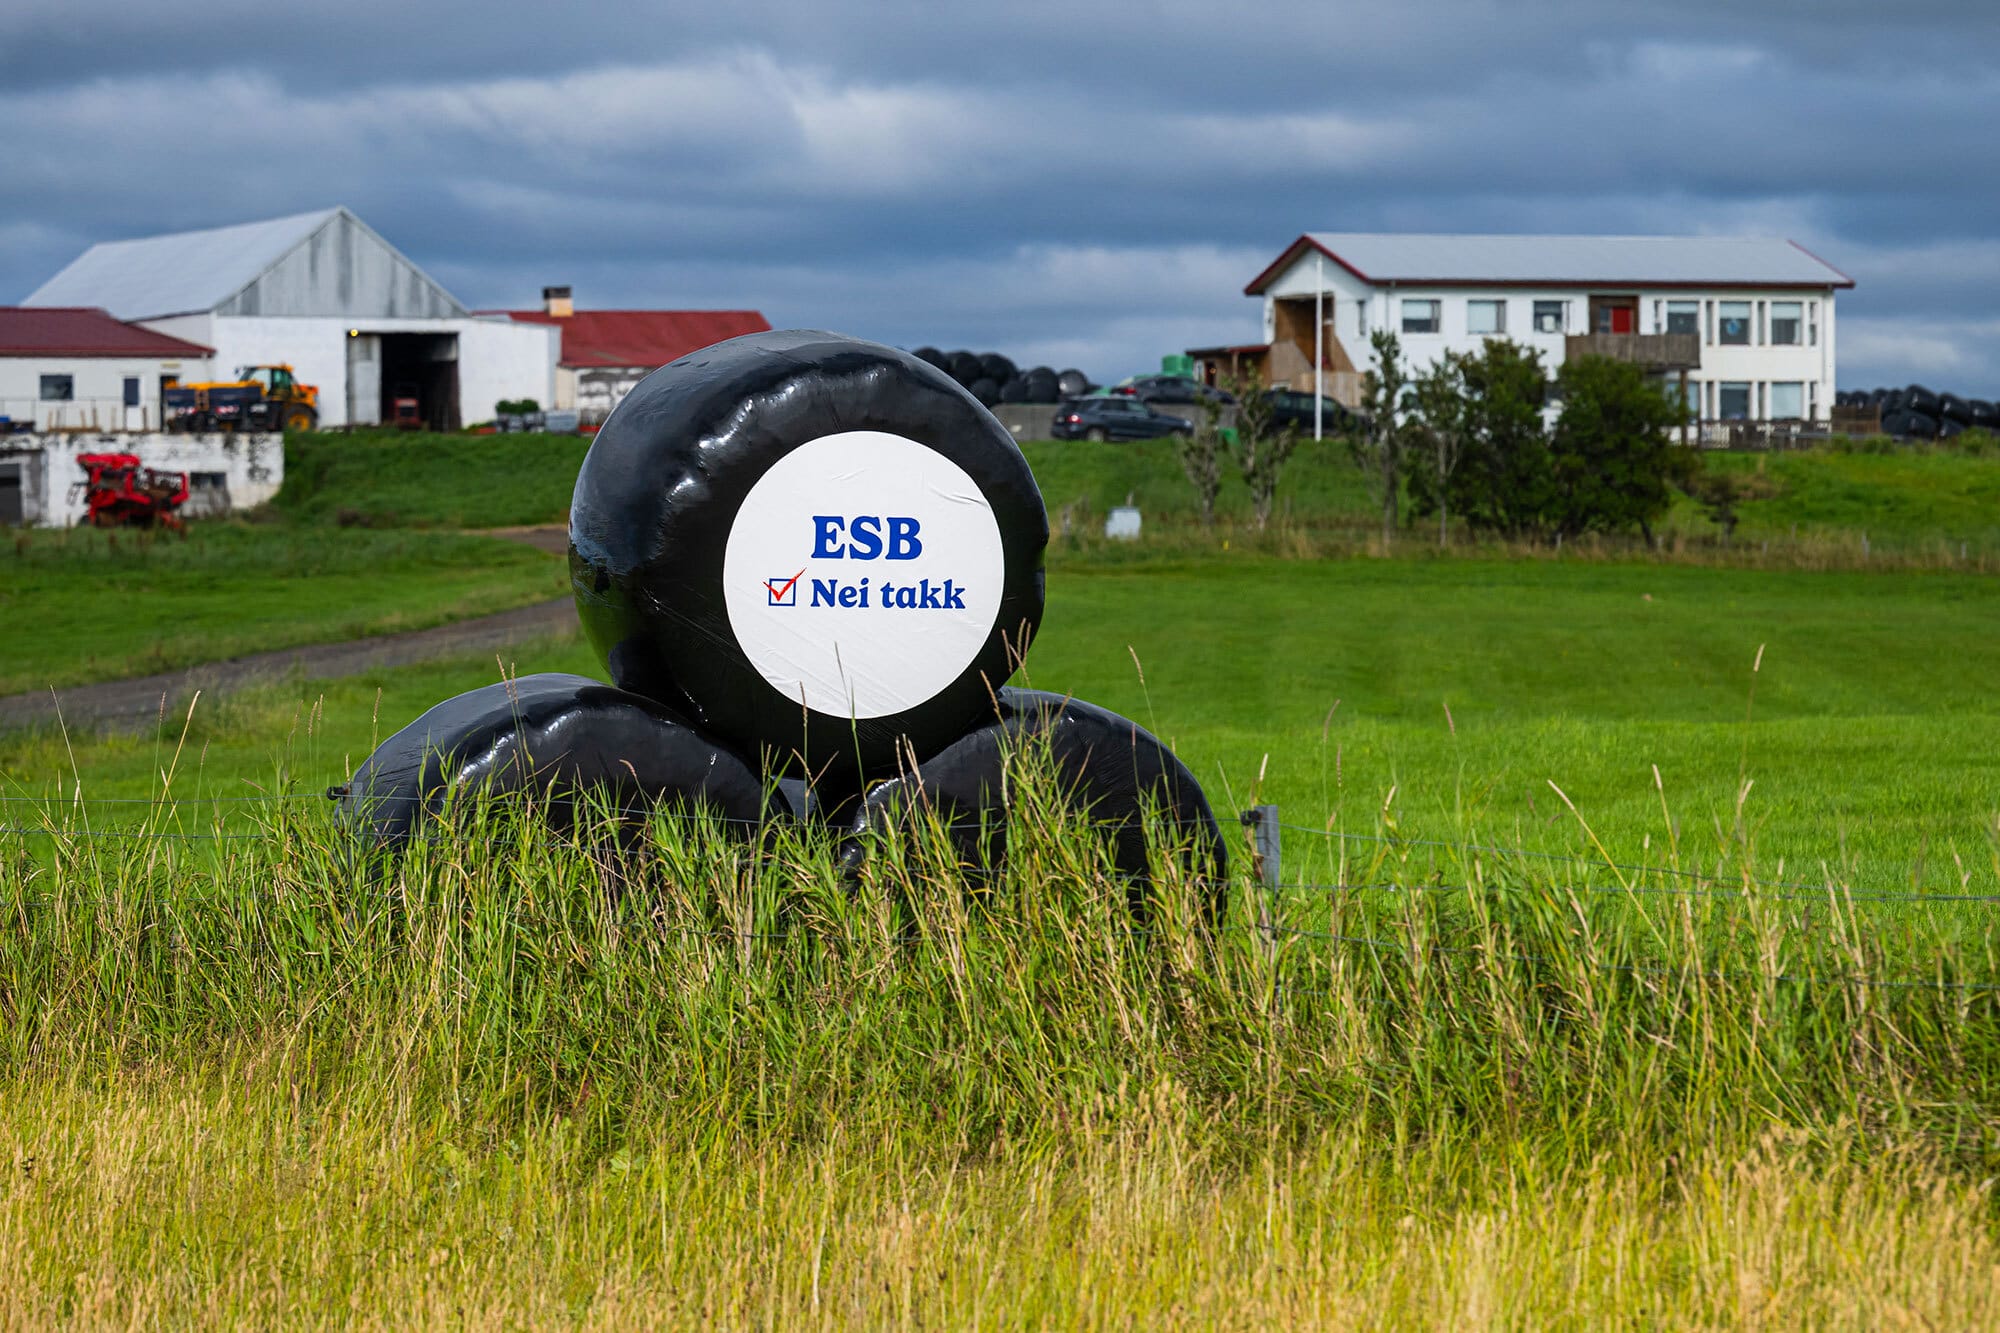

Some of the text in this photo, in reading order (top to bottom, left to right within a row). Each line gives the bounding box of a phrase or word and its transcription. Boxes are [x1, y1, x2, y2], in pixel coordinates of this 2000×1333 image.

[811, 515, 923, 561] ESB
[810, 577, 966, 610] Nei takk
